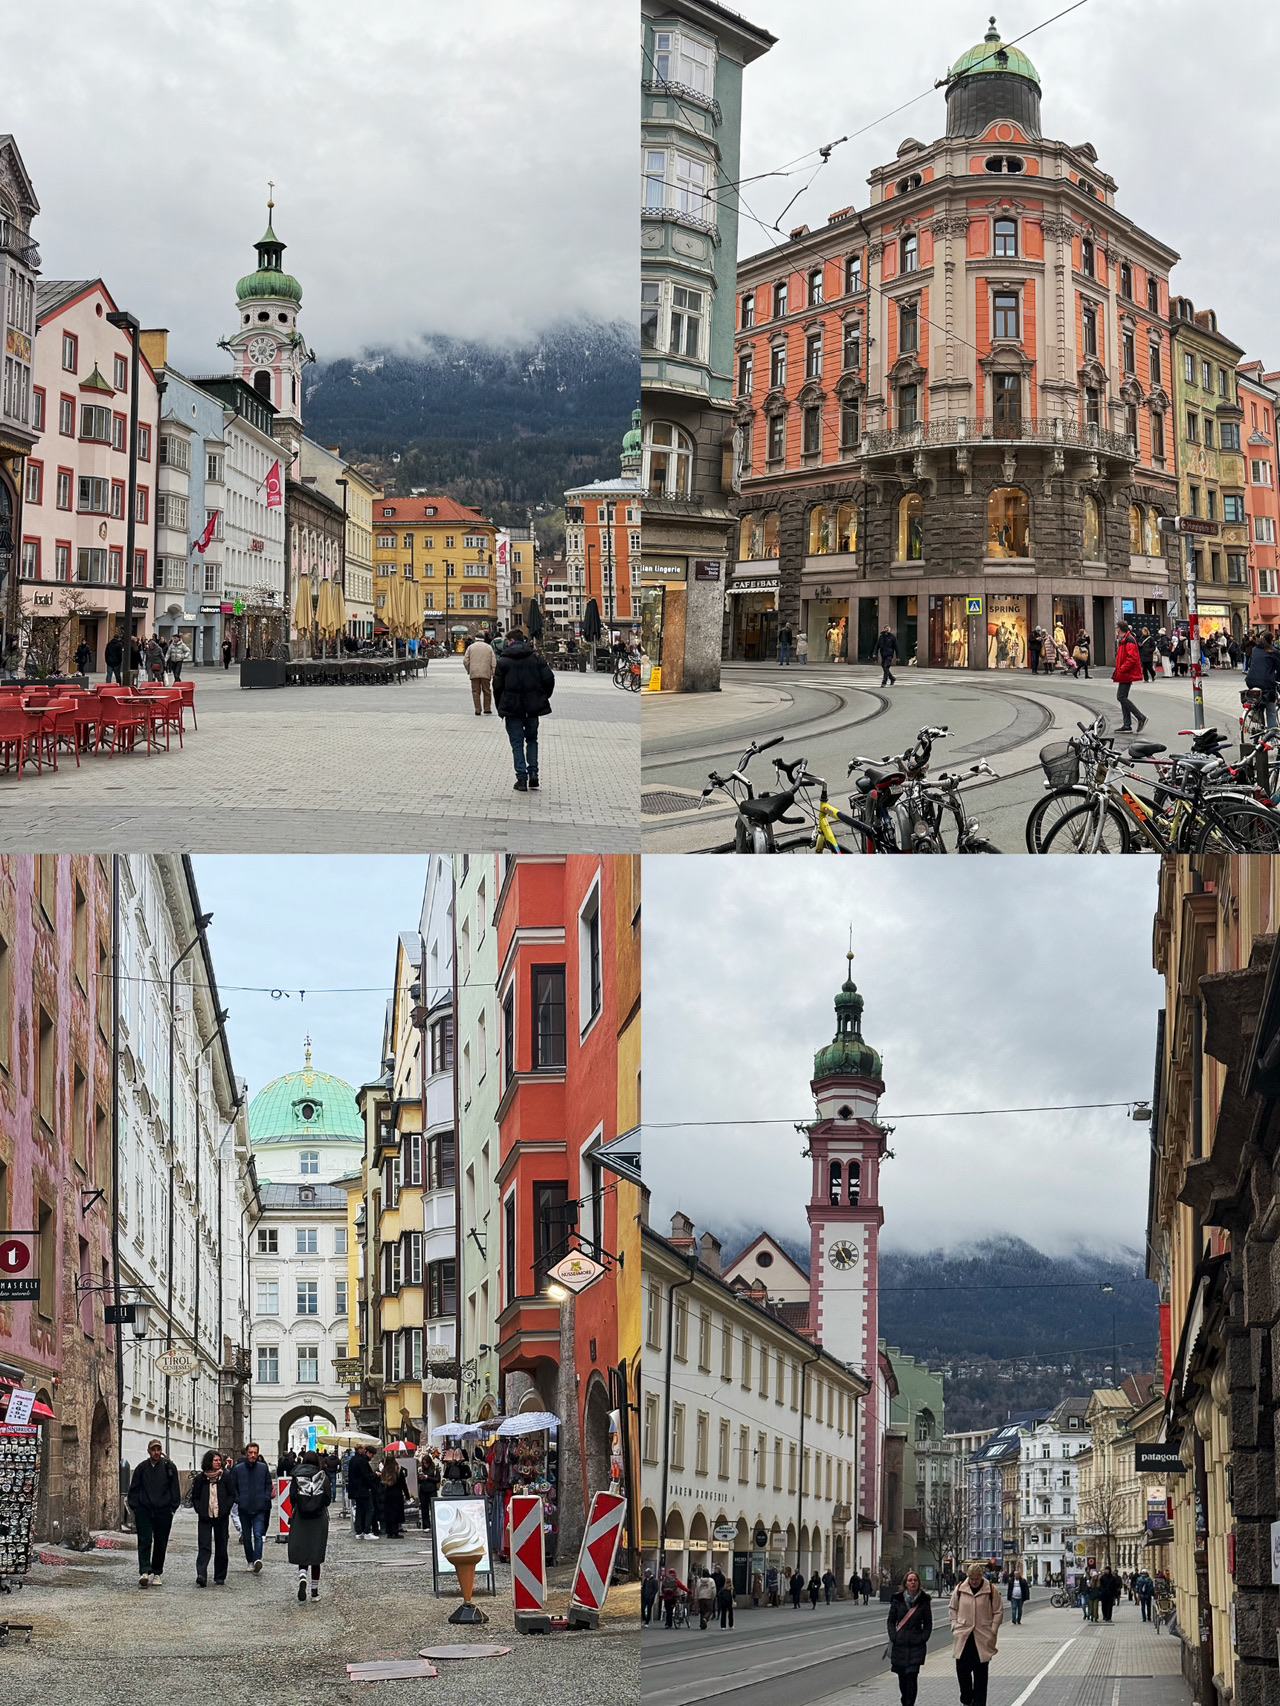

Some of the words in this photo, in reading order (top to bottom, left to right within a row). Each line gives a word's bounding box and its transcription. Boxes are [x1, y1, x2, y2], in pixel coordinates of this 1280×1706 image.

[654, 565, 681, 574] Lingerie
[989, 605, 1021, 613] SPRING
[162, 1356, 192, 1366] TIROL
